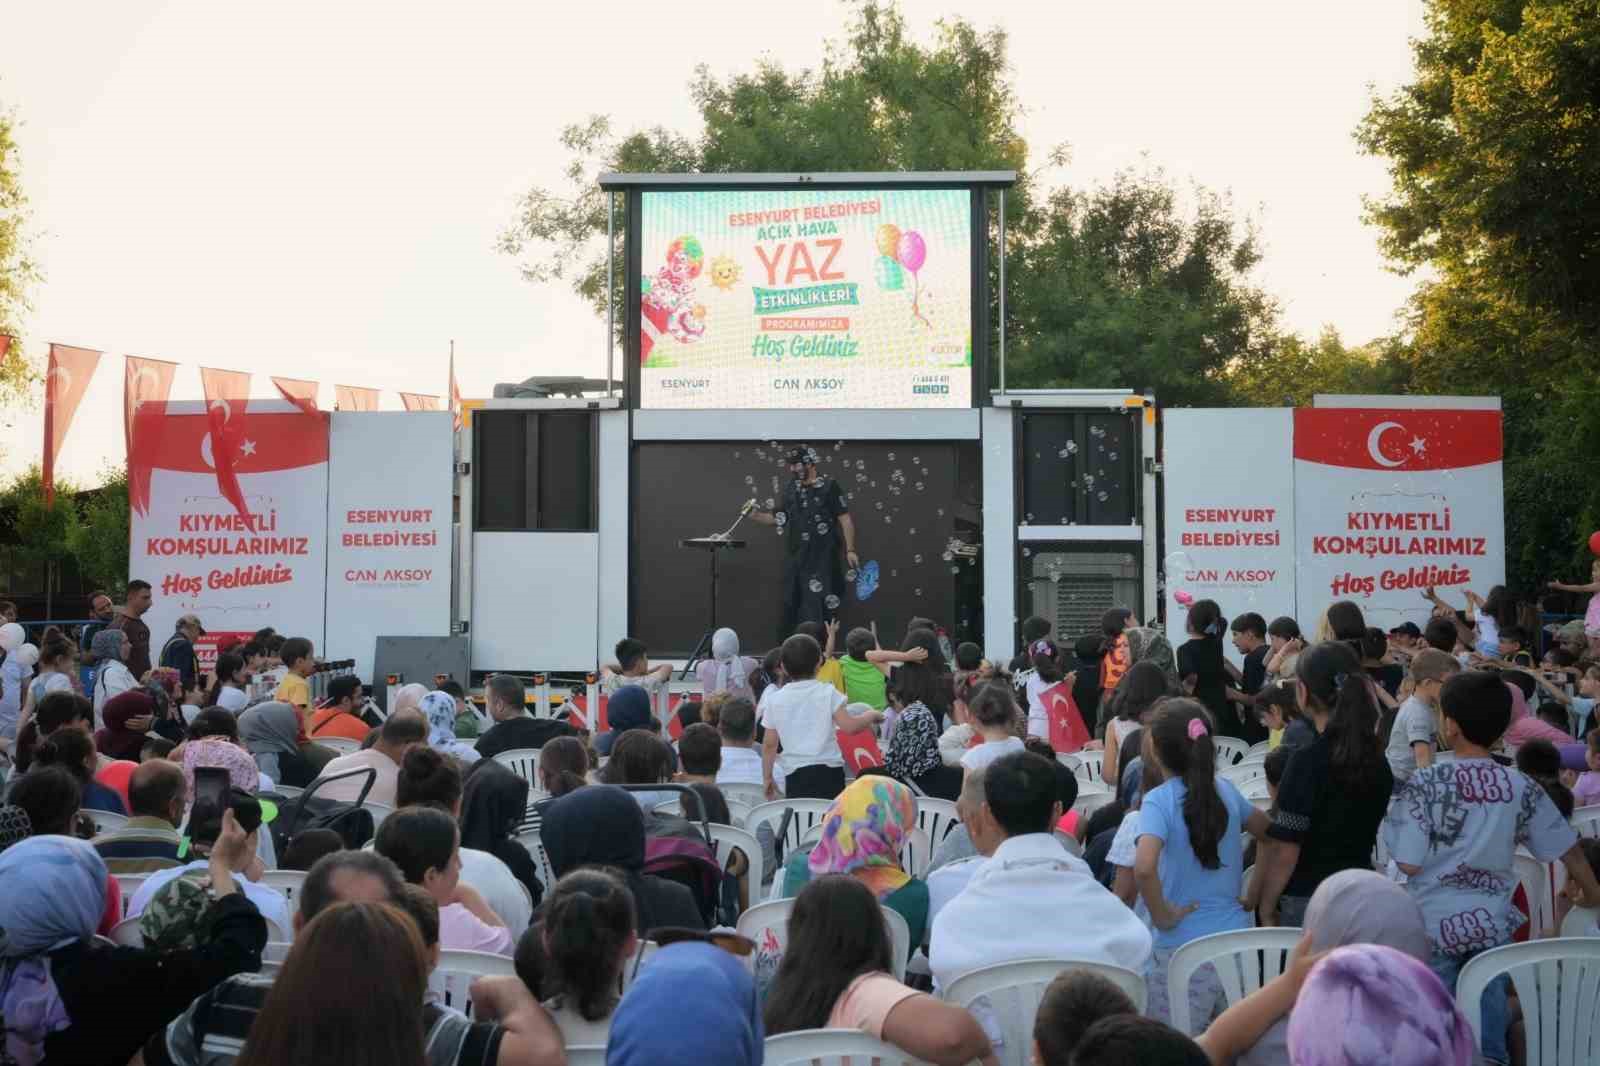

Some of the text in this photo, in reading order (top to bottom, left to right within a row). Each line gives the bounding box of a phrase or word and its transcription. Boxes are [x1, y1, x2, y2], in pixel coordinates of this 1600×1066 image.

[729, 197, 882, 227] ESENYURT BELEDİYESİ
[757, 220, 838, 241] AÇIK HAVA
[754, 238, 846, 286] YAZ
[761, 286, 851, 309] ETKİNLİKLERİ
[752, 334, 859, 362] Hoş Geldiniz
[661, 379, 710, 389] ESENYURT
[773, 378, 845, 390] CAN AKSOY
[179, 508, 277, 533] KIYMETLİ
[346, 510, 433, 524] ESENYURT
[1185, 509, 1276, 523] ESENYURT
[1347, 507, 1452, 532] KIYMETLİ
[147, 537, 309, 560] KOMŞULARIMIZ
[341, 529, 437, 547] BELEDİYESİ
[1181, 529, 1280, 547] BELEDİYESİ
[1313, 536, 1486, 558] KOMŞULARIMIZ
[161, 562, 293, 598] Hoş Geldiniz
[345, 569, 432, 582] CAN AKSOY
[1185, 570, 1276, 582] CAN AKSOY
[1331, 563, 1470, 598] Hoş Geldiniz
